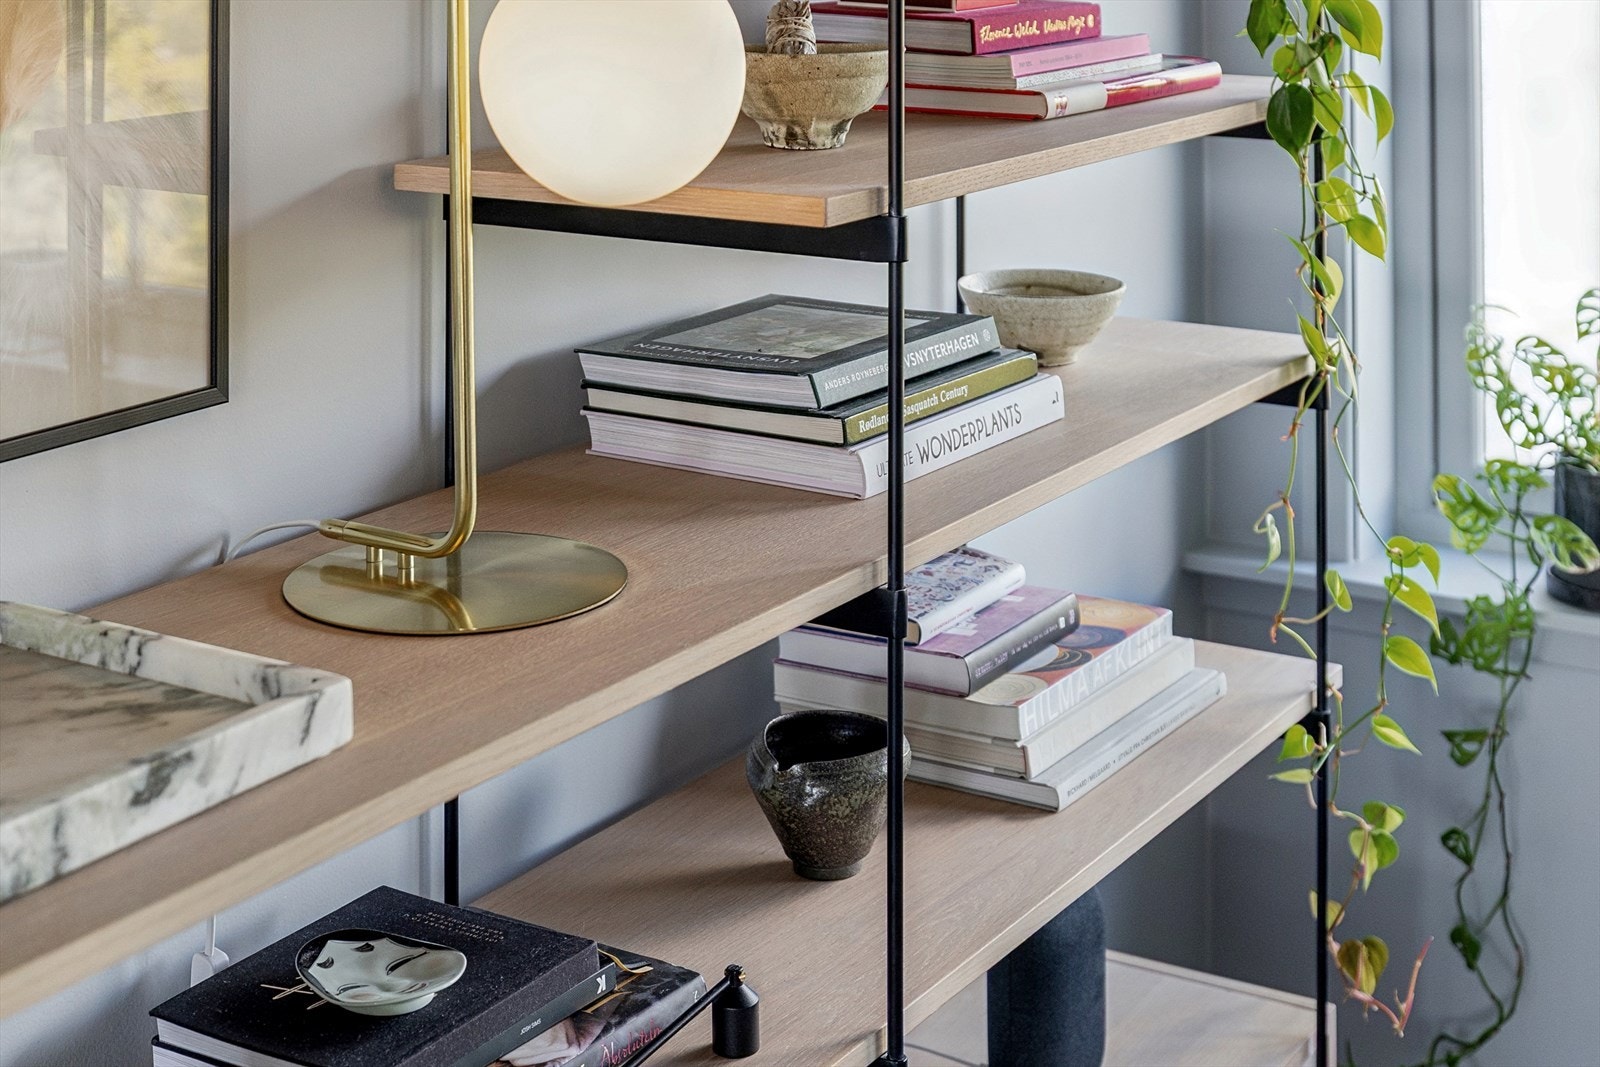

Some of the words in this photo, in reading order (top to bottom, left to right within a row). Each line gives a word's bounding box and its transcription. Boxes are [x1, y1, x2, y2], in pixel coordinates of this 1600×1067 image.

[904, 333, 980, 368] VSNYTERHAGEN
[824, 376, 851, 391] ANDERS
[939, 384, 968, 403] Century
[876, 450, 914, 478] ULTE
[915, 402, 1022, 465] WONDERPLANTS
[1024, 669, 1090, 737] HILMA
[1093, 659, 1113, 688] AF
[1115, 631, 1164, 676] KLINT
